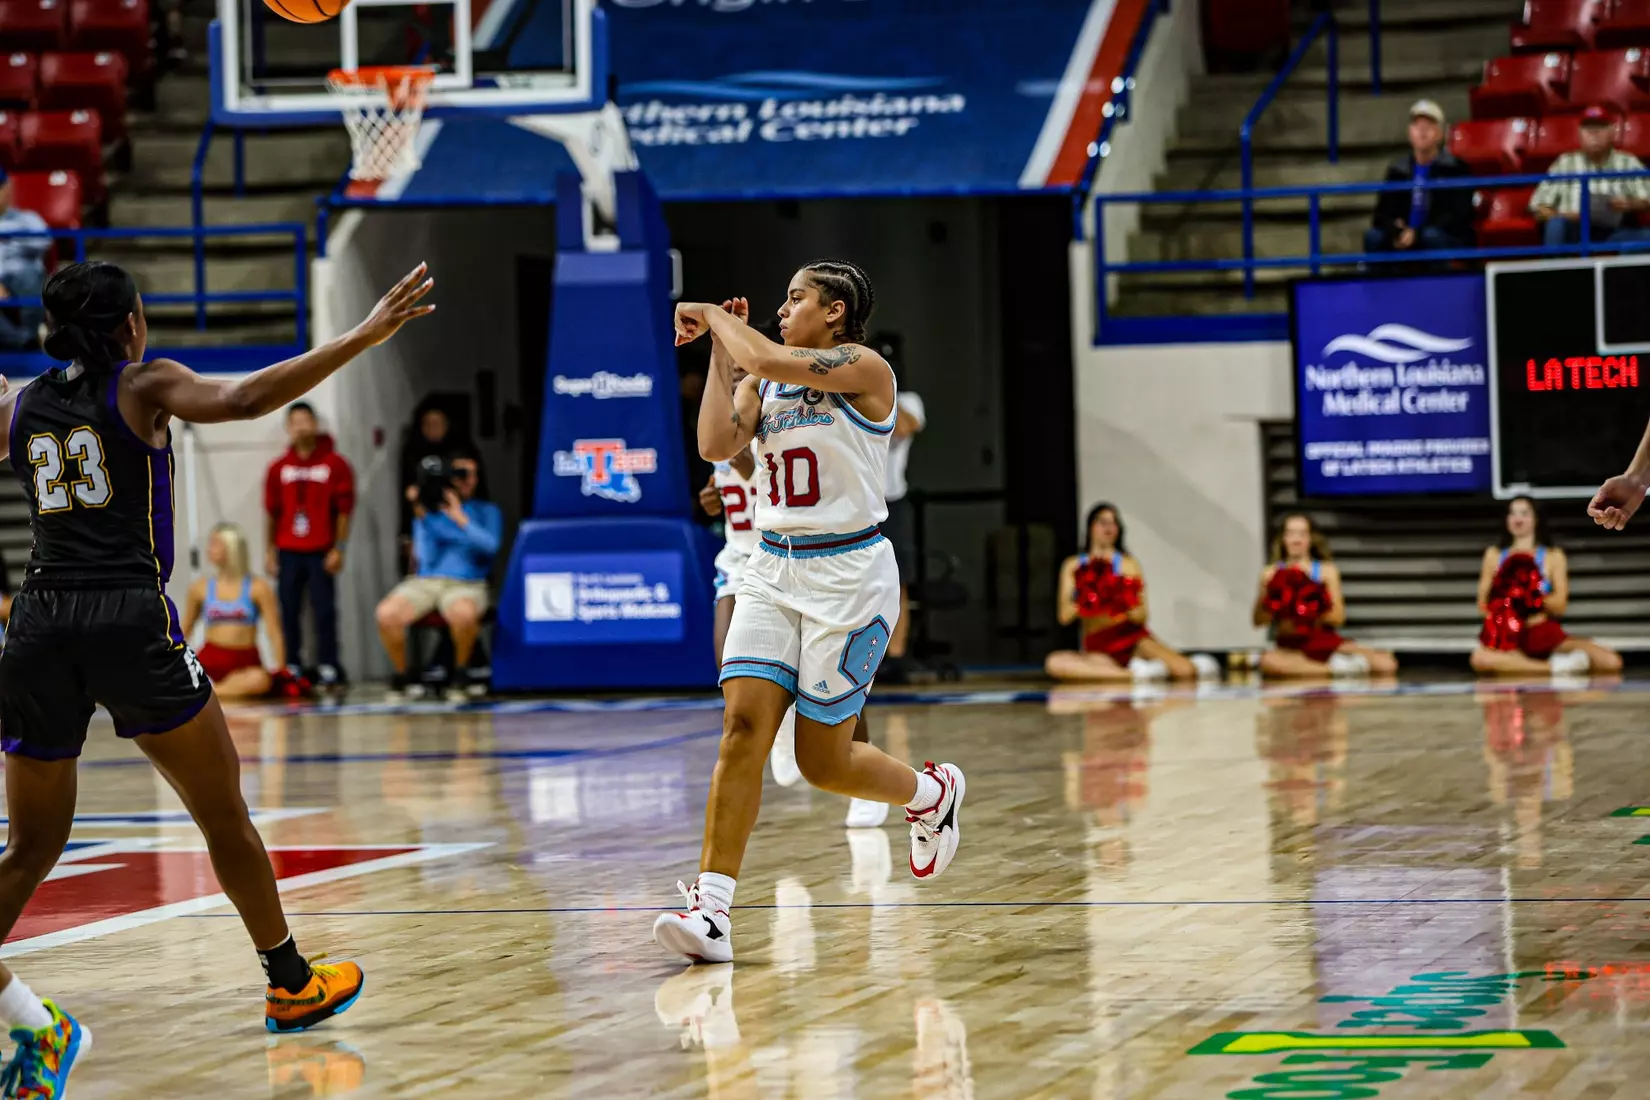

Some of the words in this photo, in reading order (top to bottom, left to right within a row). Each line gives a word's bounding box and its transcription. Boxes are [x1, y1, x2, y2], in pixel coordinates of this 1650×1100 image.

[760, 93, 966, 120] Louisiana
[760, 117, 918, 141] Center
[1305, 361, 1394, 389] Northern
[1396, 358, 1484, 386] Louisiana
[1322, 386, 1399, 416] Medical
[1401, 385, 1469, 414] Center
[27, 425, 113, 514] 23
[764, 447, 821, 507] 10
